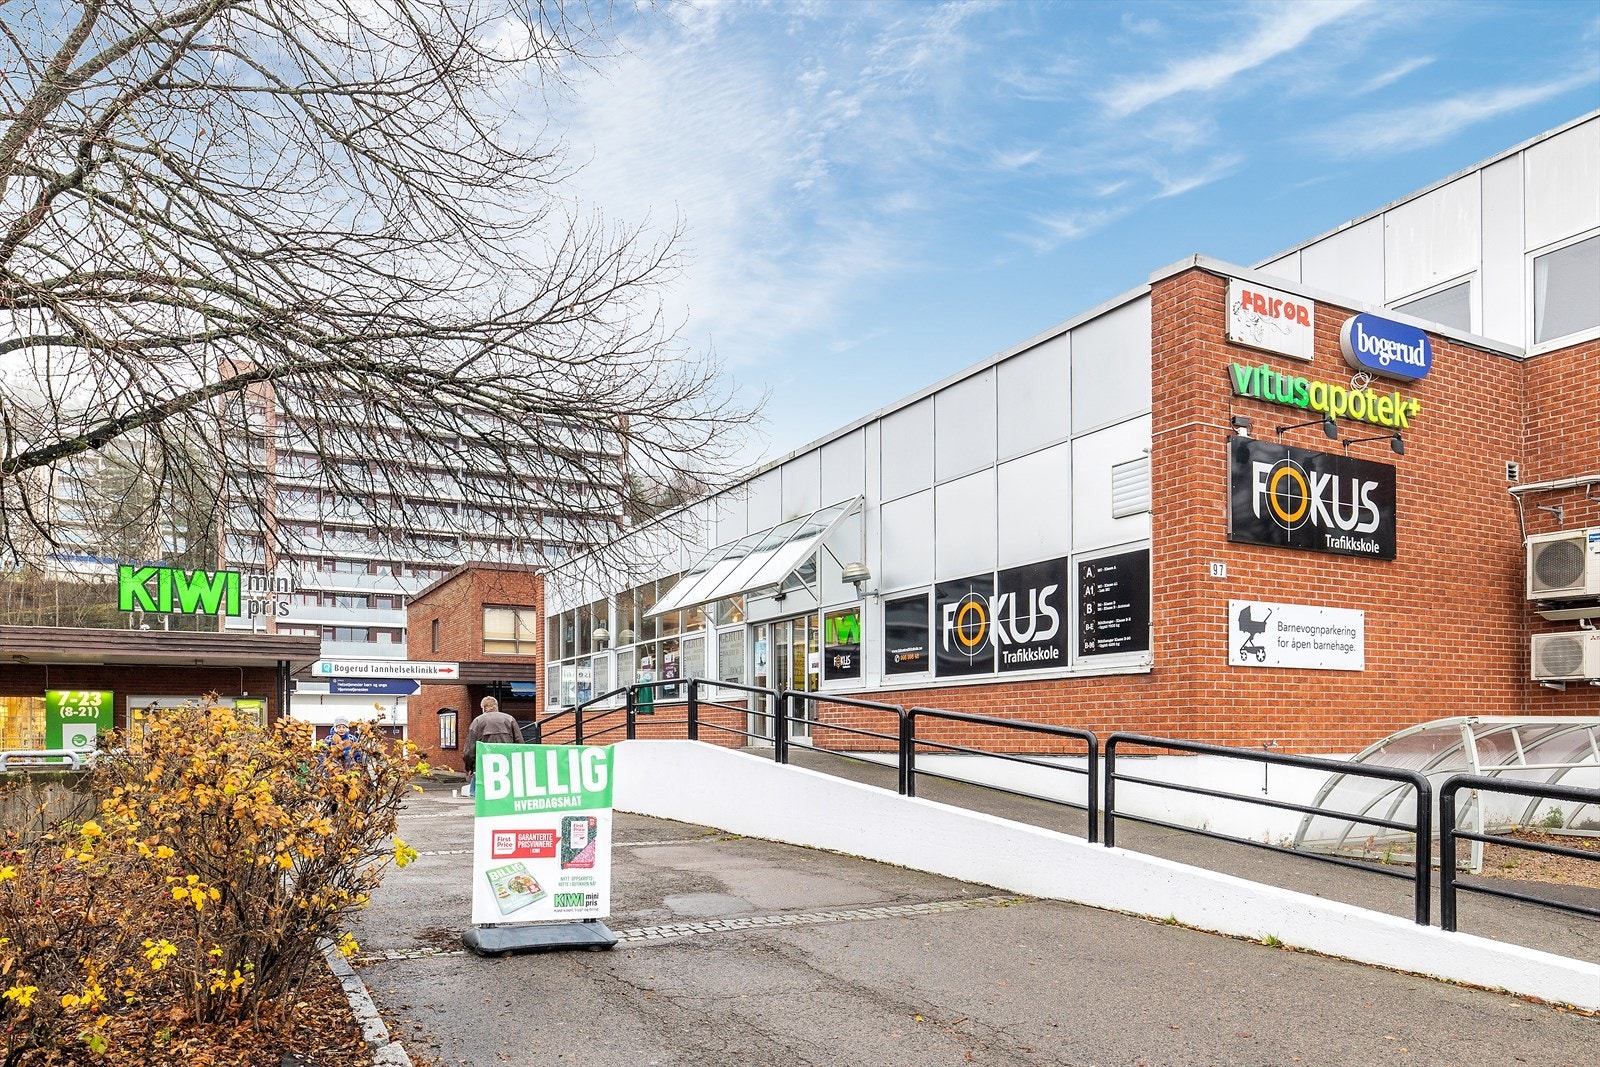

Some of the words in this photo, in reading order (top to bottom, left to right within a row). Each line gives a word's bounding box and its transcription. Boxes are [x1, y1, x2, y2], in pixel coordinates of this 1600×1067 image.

[1242, 290, 1311, 327] FRISØR
[1357, 323, 1426, 366] bogerud
[1252, 459, 1380, 534] FOKUS
[1325, 534, 1380, 554] Trafikkskole
[1086, 567, 1093, 578] A
[1213, 564, 1224, 576] 97
[118, 565, 242, 617] KIWI
[248, 573, 296, 594] mini
[1085, 585, 1094, 596] A1
[247, 596, 291, 619] pris
[1086, 603, 1093, 614] B
[943, 584, 1060, 655] FOKUS
[1277, 621, 1357, 639] Barnevognparkering
[1277, 636, 1290, 648] for
[1291, 637, 1311, 653] åpen
[1313, 639, 1357, 655] barnehage.
[833, 655, 851, 667] FOKUS
[1002, 649, 1059, 664] Trafikkskole
[334, 664, 369, 674] Bogerud
[371, 665, 438, 674] Tannhelseklinikk
[58, 691, 102, 706] 7-23
[60, 707, 99, 718] (8-21)
[482, 747, 608, 801] BILLIG
[514, 795, 582, 812] HVERDAGSMAT
[517, 833, 553, 841] GARANTERTE
[517, 840, 553, 848] PRISVINNERE
[489, 863, 524, 880] BILLIG
[554, 893, 585, 907] KIWI
